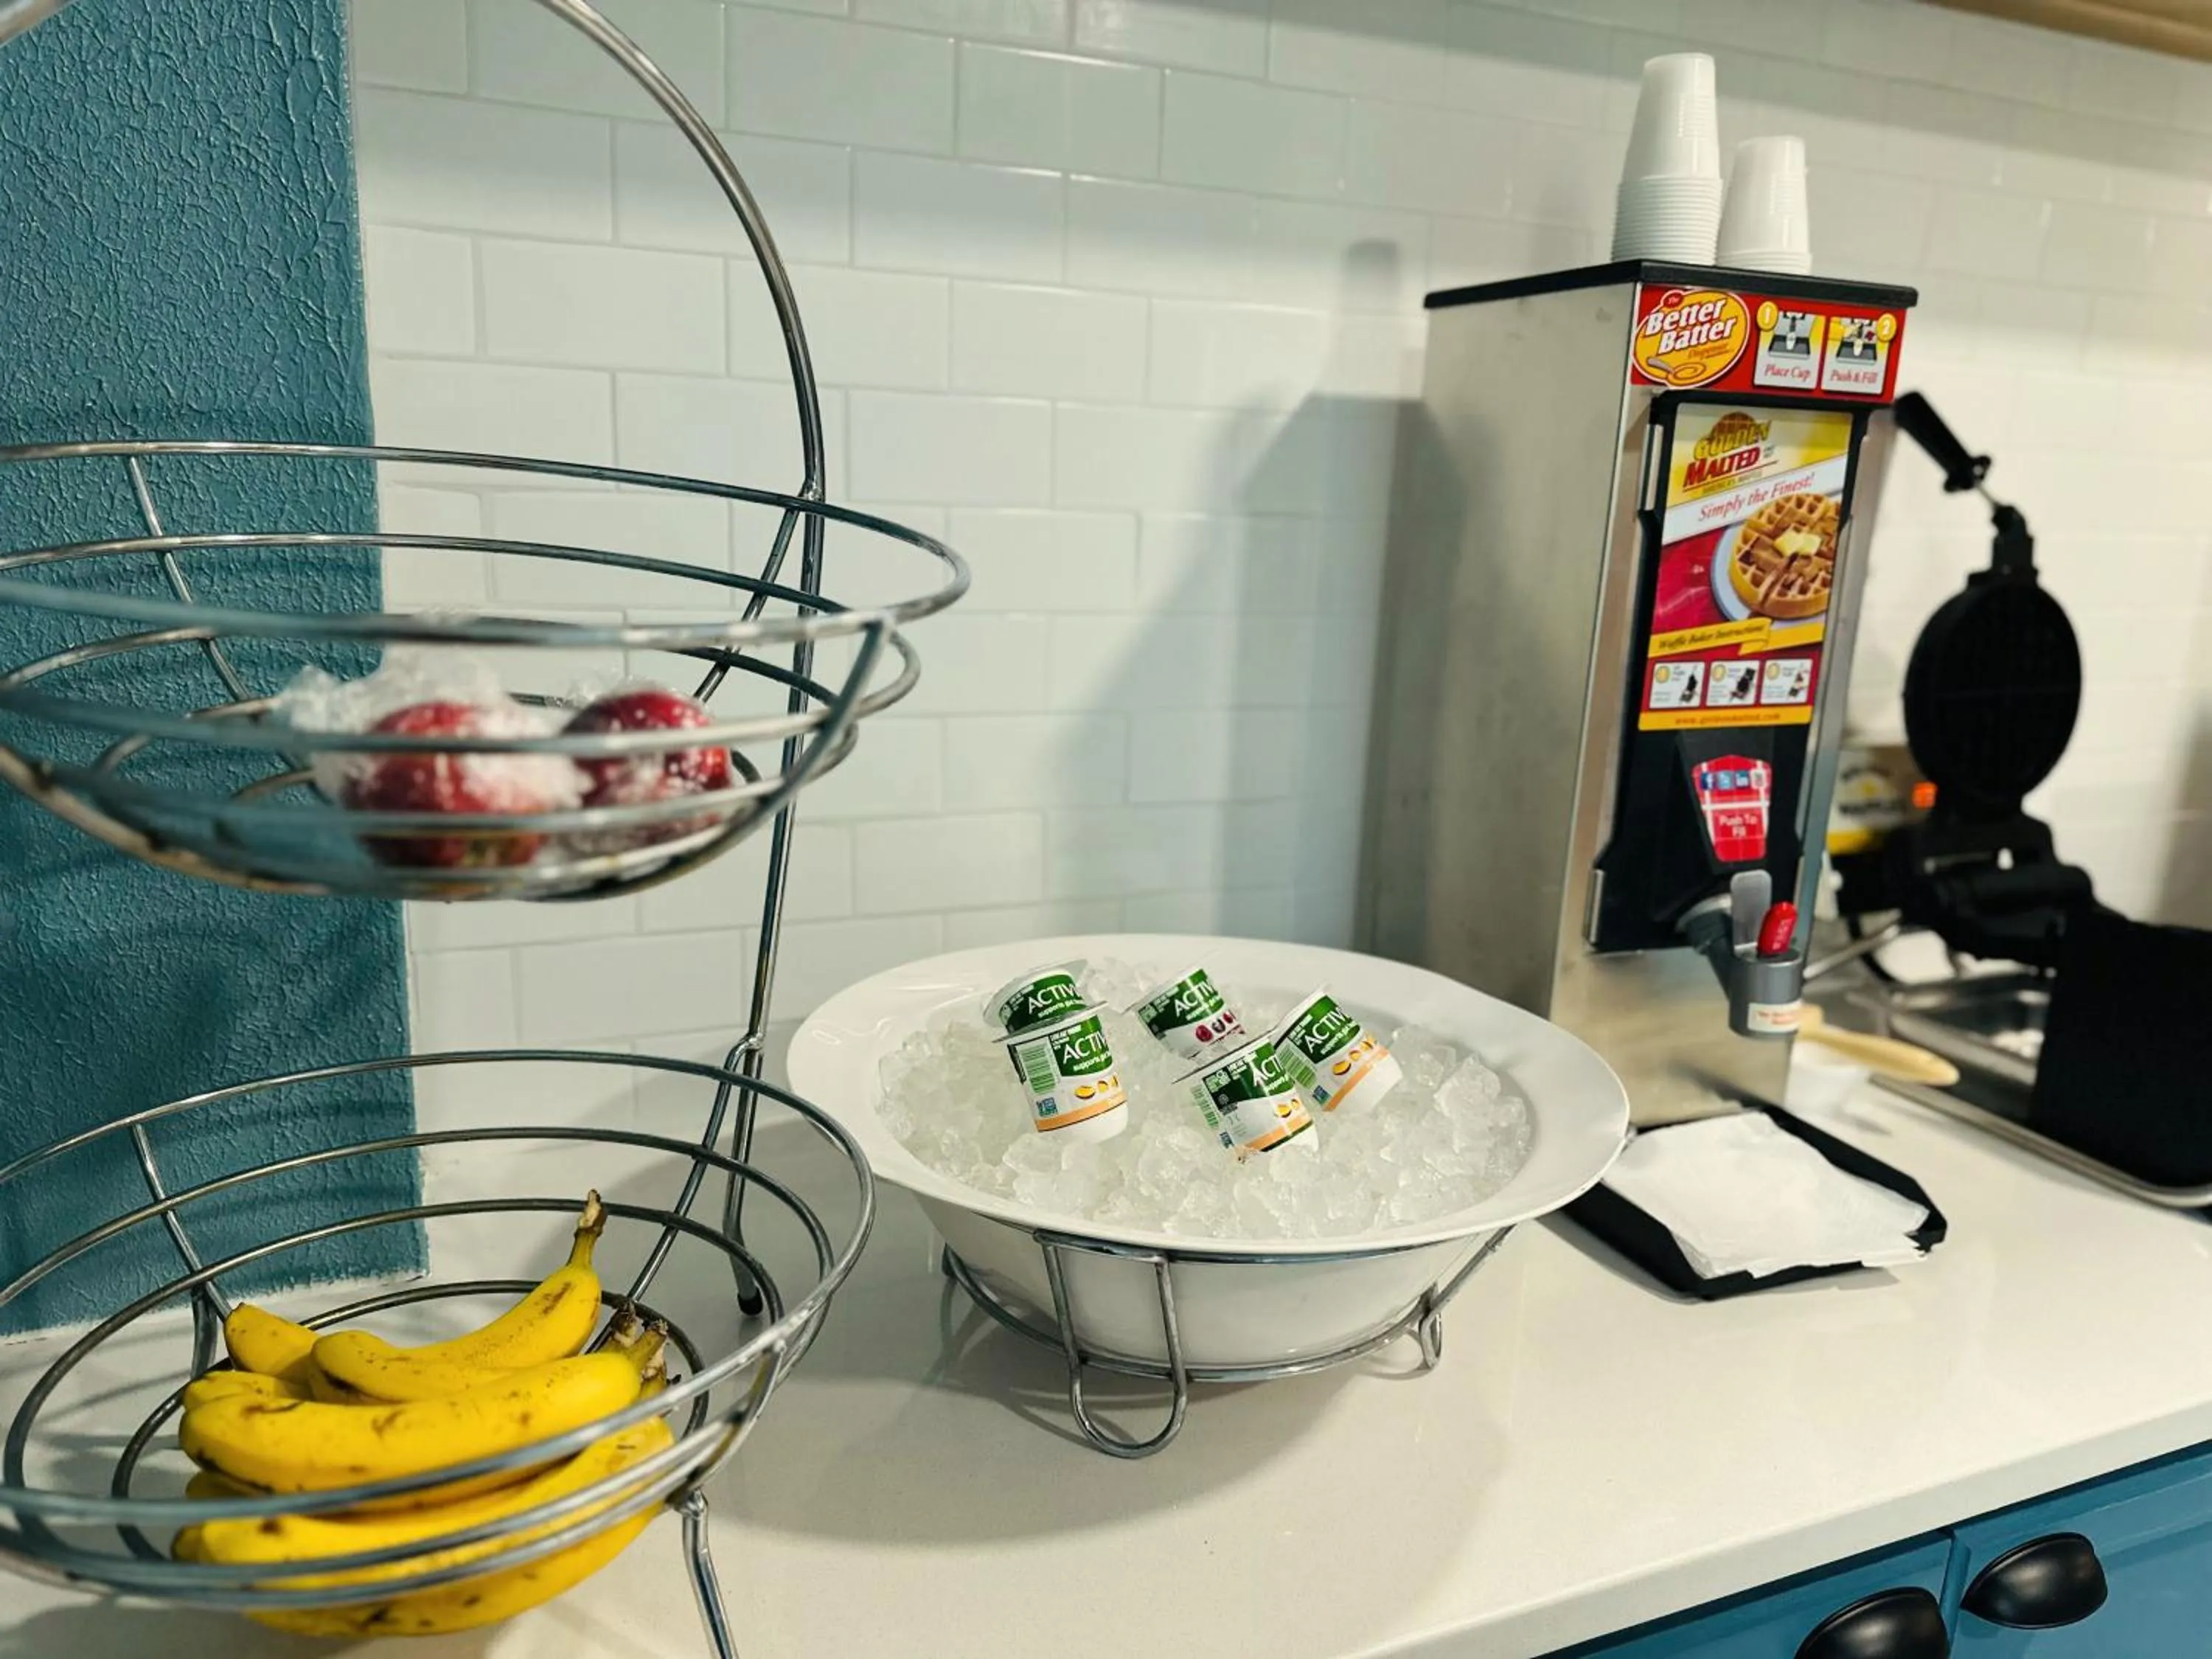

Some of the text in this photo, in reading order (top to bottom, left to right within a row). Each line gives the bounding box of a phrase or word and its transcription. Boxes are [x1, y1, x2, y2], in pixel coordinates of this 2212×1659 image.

[1645, 299, 1726, 335] Better
[1658, 318, 1736, 354] Batter
[1764, 364, 1812, 383] Place Cup
[1694, 420, 1771, 460] GOLDEN
[1682, 446, 1760, 487] MALTED
[1700, 495, 1745, 521] Simply
[1747, 487, 1768, 506] the
